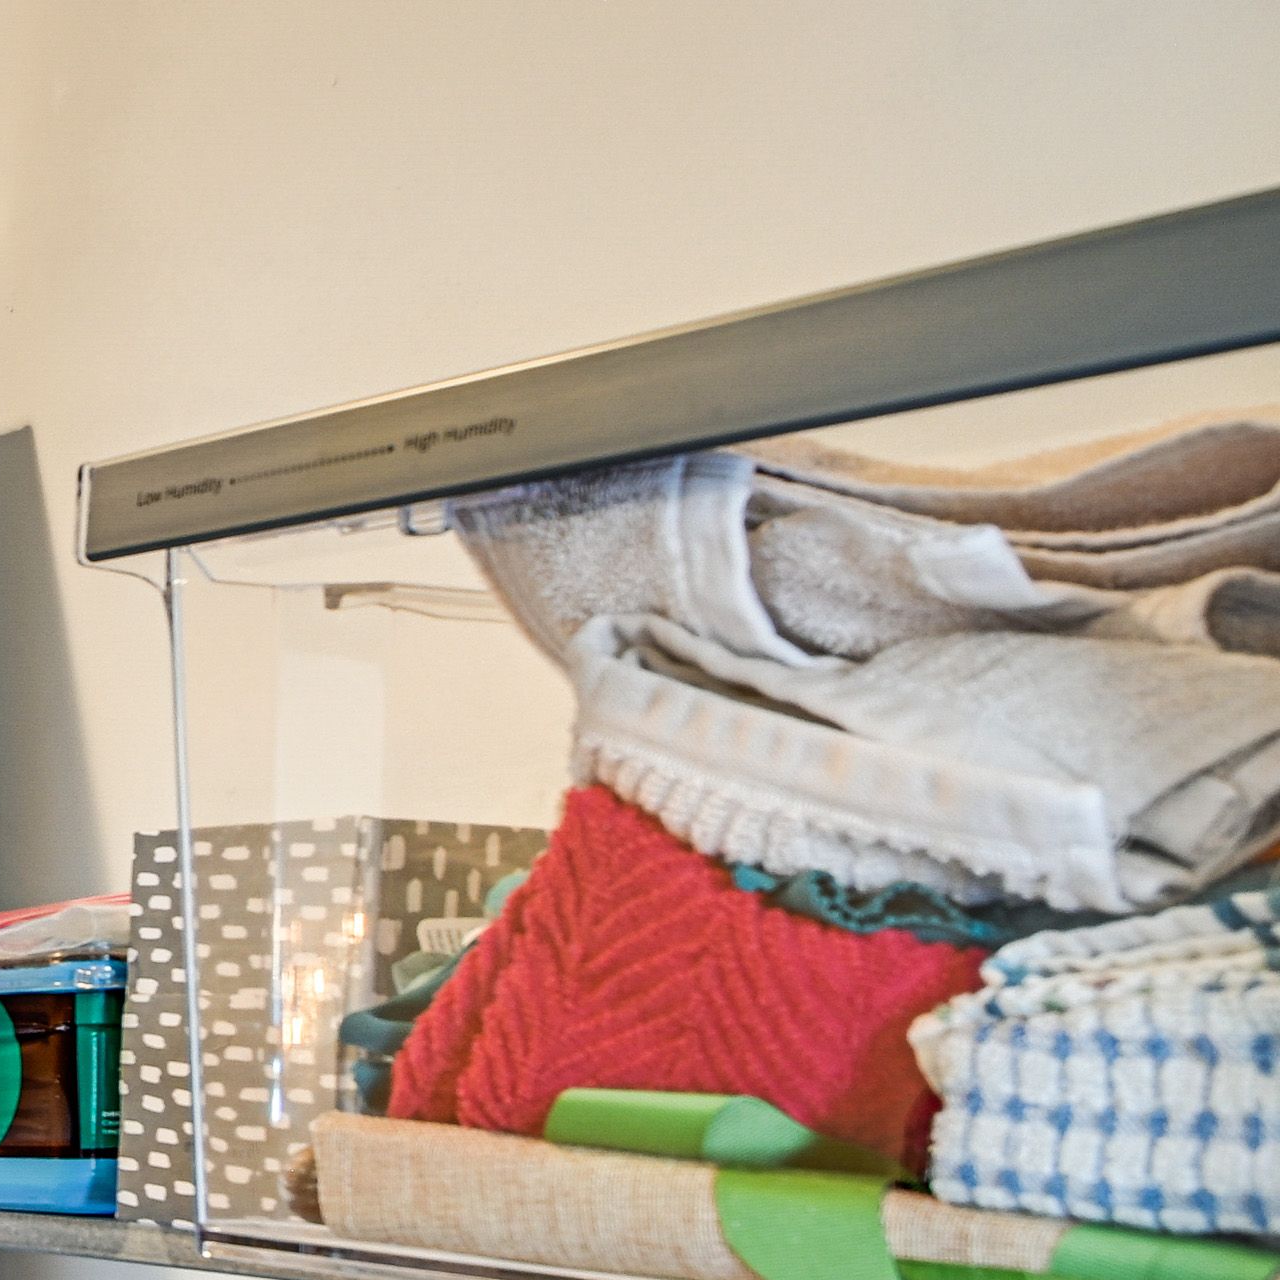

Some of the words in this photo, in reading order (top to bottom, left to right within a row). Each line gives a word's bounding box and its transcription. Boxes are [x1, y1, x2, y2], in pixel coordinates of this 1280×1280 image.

[136, 490, 162, 508] Low
[165, 477, 223, 502] Humidity
[405, 431, 438, 455] High
[444, 416, 517, 444] Humidity
